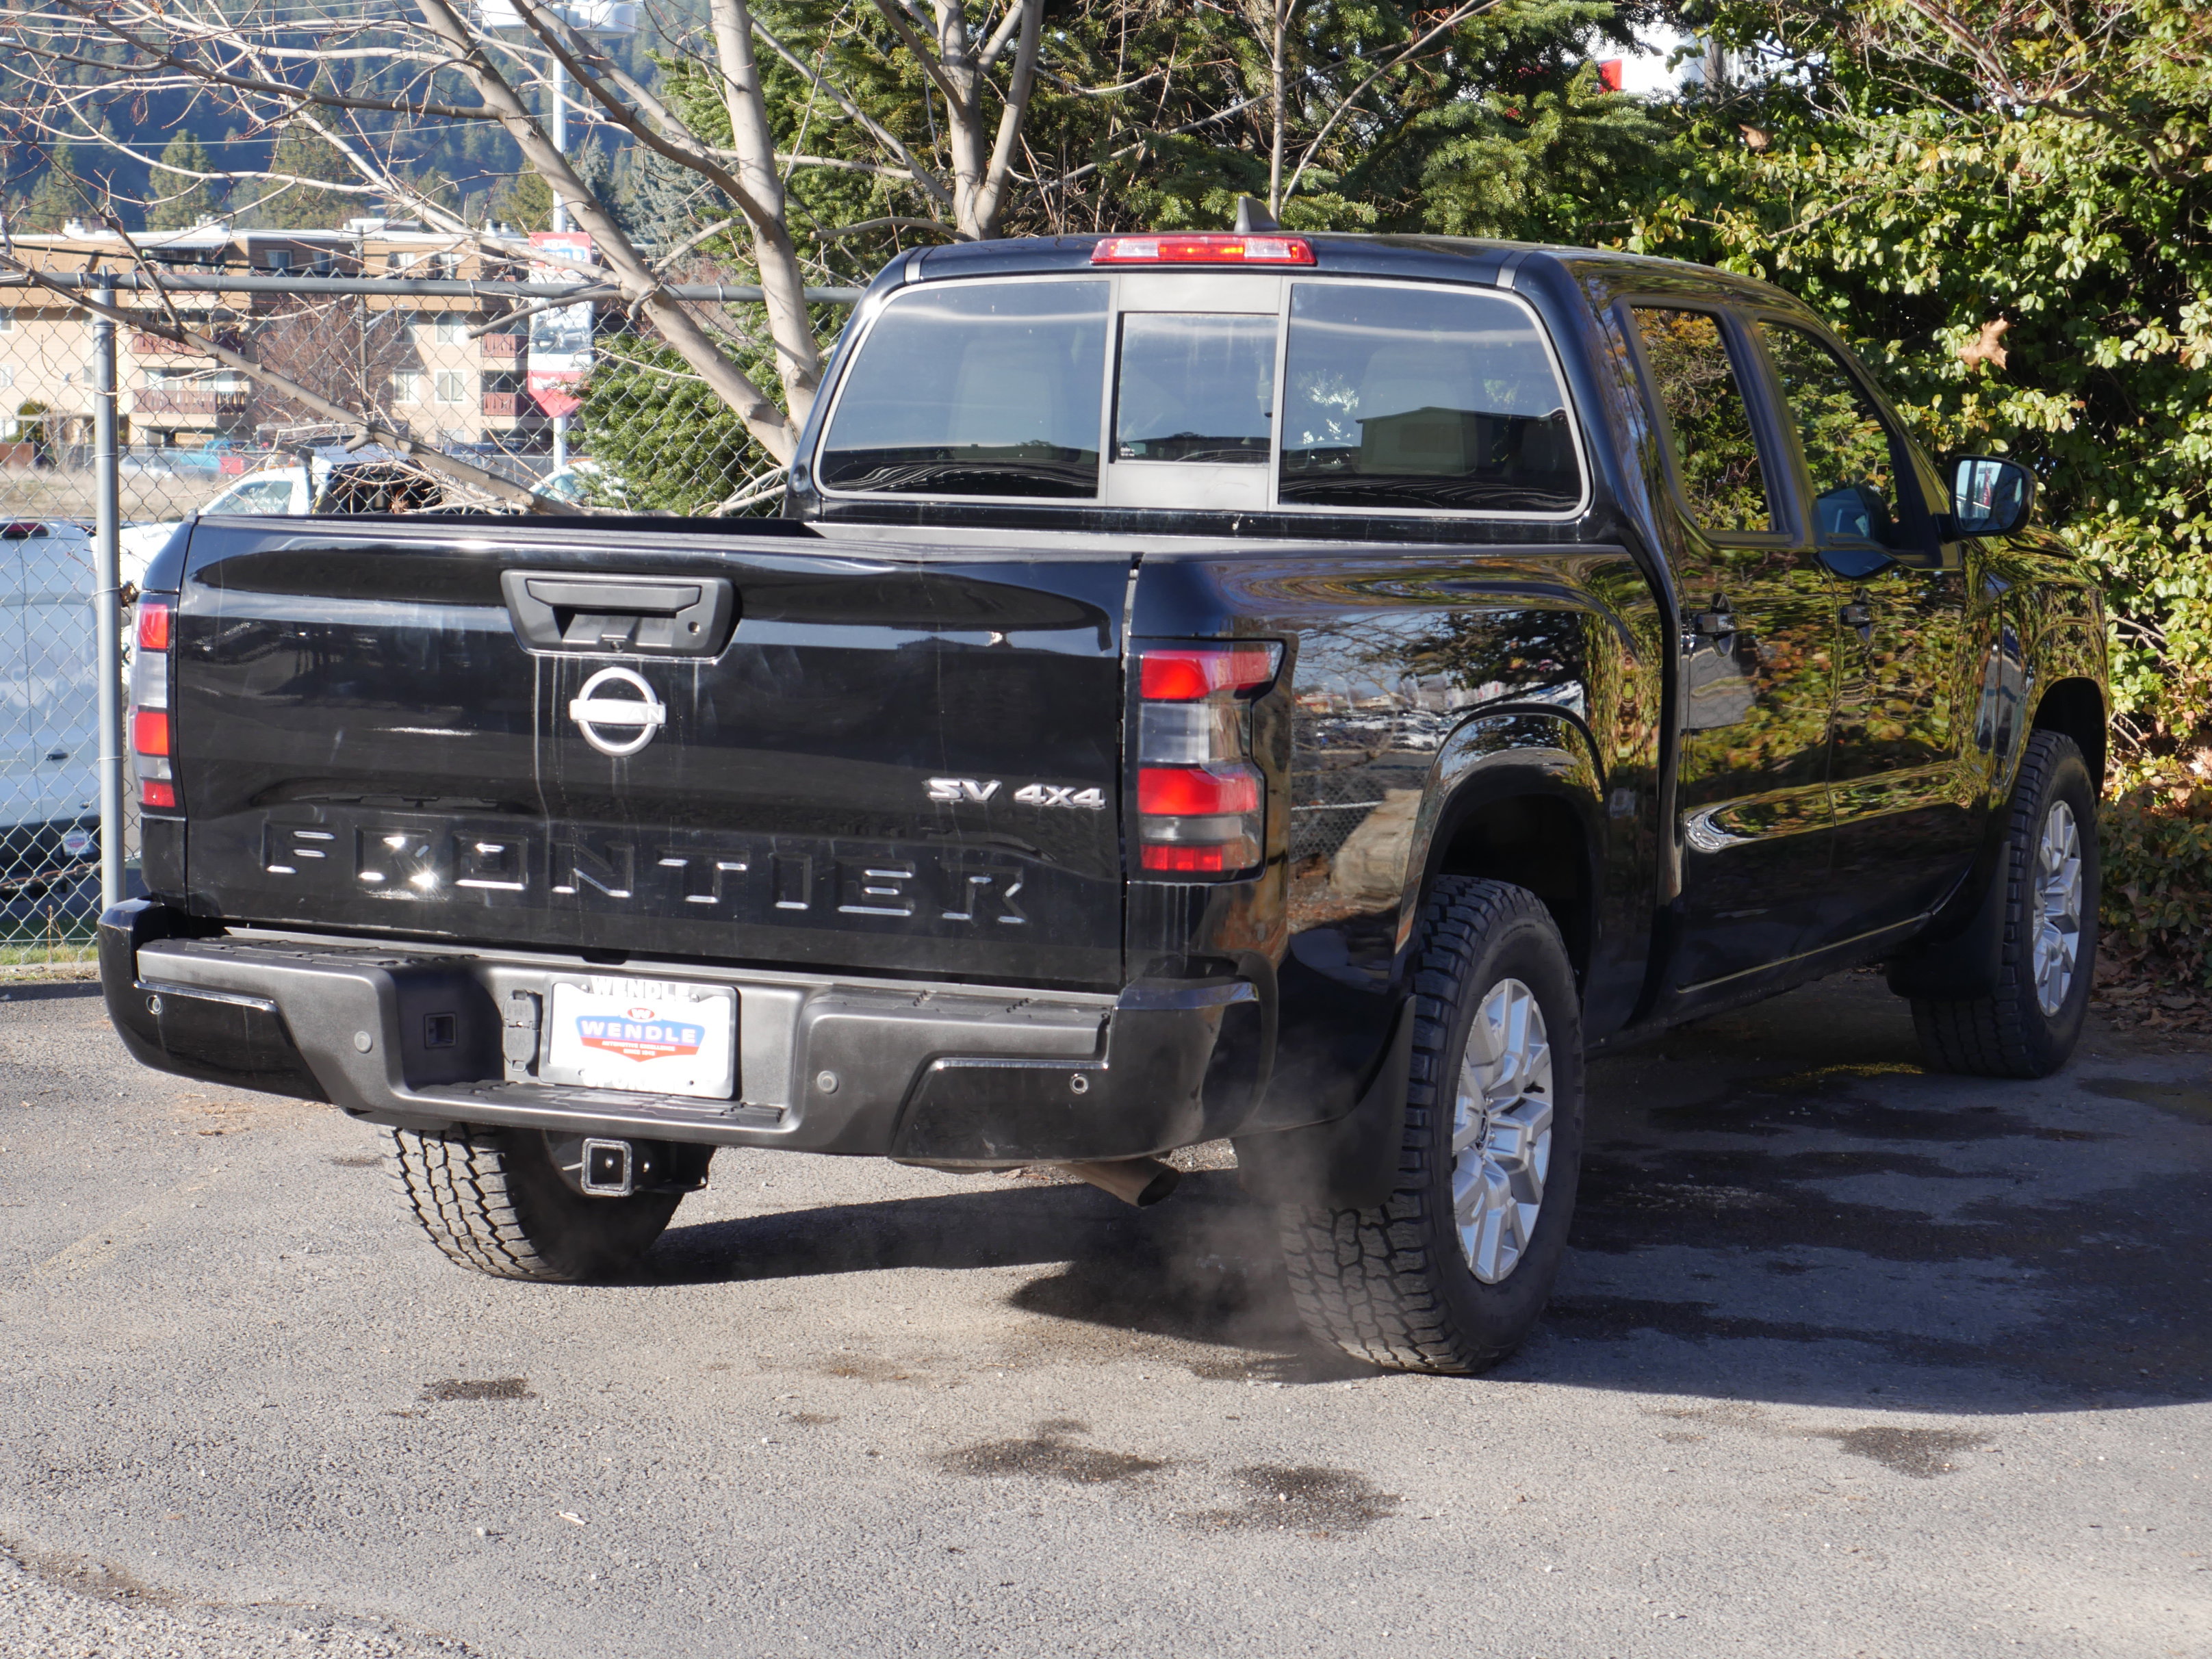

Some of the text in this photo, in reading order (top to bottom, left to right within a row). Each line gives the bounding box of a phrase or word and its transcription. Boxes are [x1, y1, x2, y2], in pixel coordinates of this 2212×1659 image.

[929, 777, 1002, 801] SV
[262, 822, 1027, 925] FRONTIER
[590, 976, 690, 1001] WENDLE
[631, 1008, 652, 1020] W
[581, 1020, 696, 1044] WENDLE
